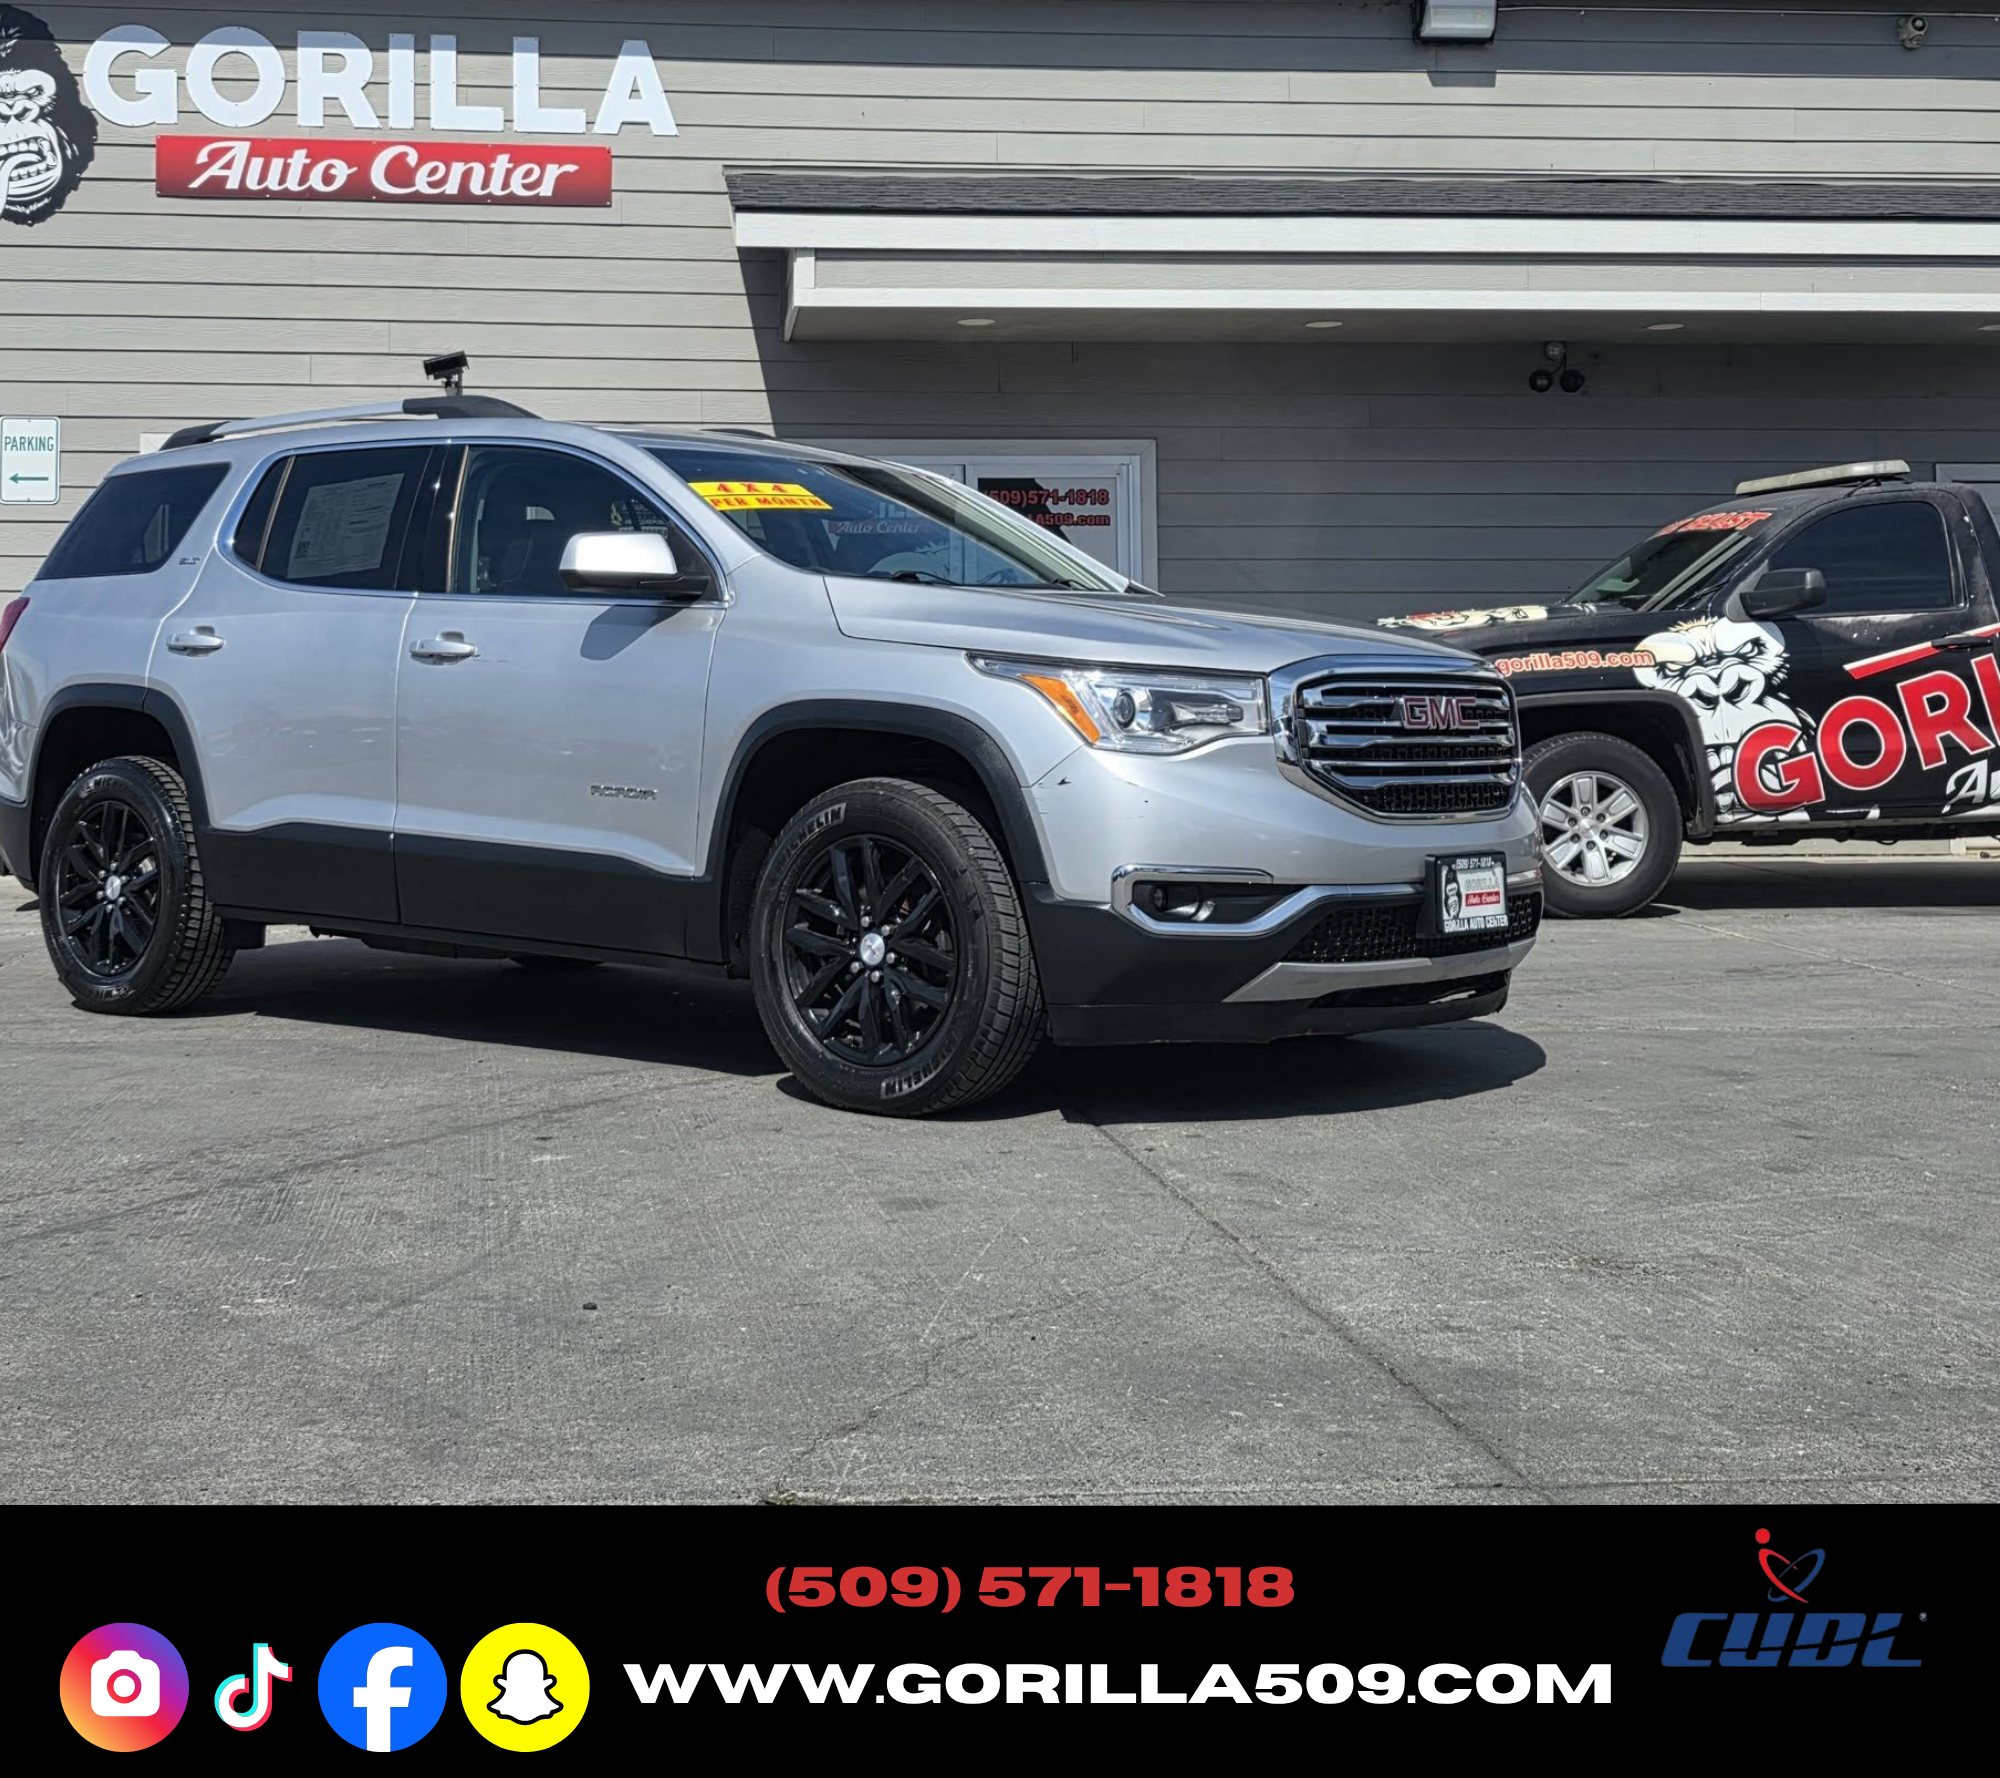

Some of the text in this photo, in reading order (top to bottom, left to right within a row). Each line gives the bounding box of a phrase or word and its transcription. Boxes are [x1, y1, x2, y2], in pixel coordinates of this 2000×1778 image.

[84, 24, 679, 136] GORILLA
[188, 141, 580, 198] Auto Center
[4, 435, 55, 452] PARKING
[710, 497, 822, 507] PER MONTH
[1495, 650, 1655, 677] gorilla509.com
[1402, 696, 1481, 730] GMC
[1444, 918, 1469, 933] GORILLA
[1469, 916, 1486, 930] AUTO
